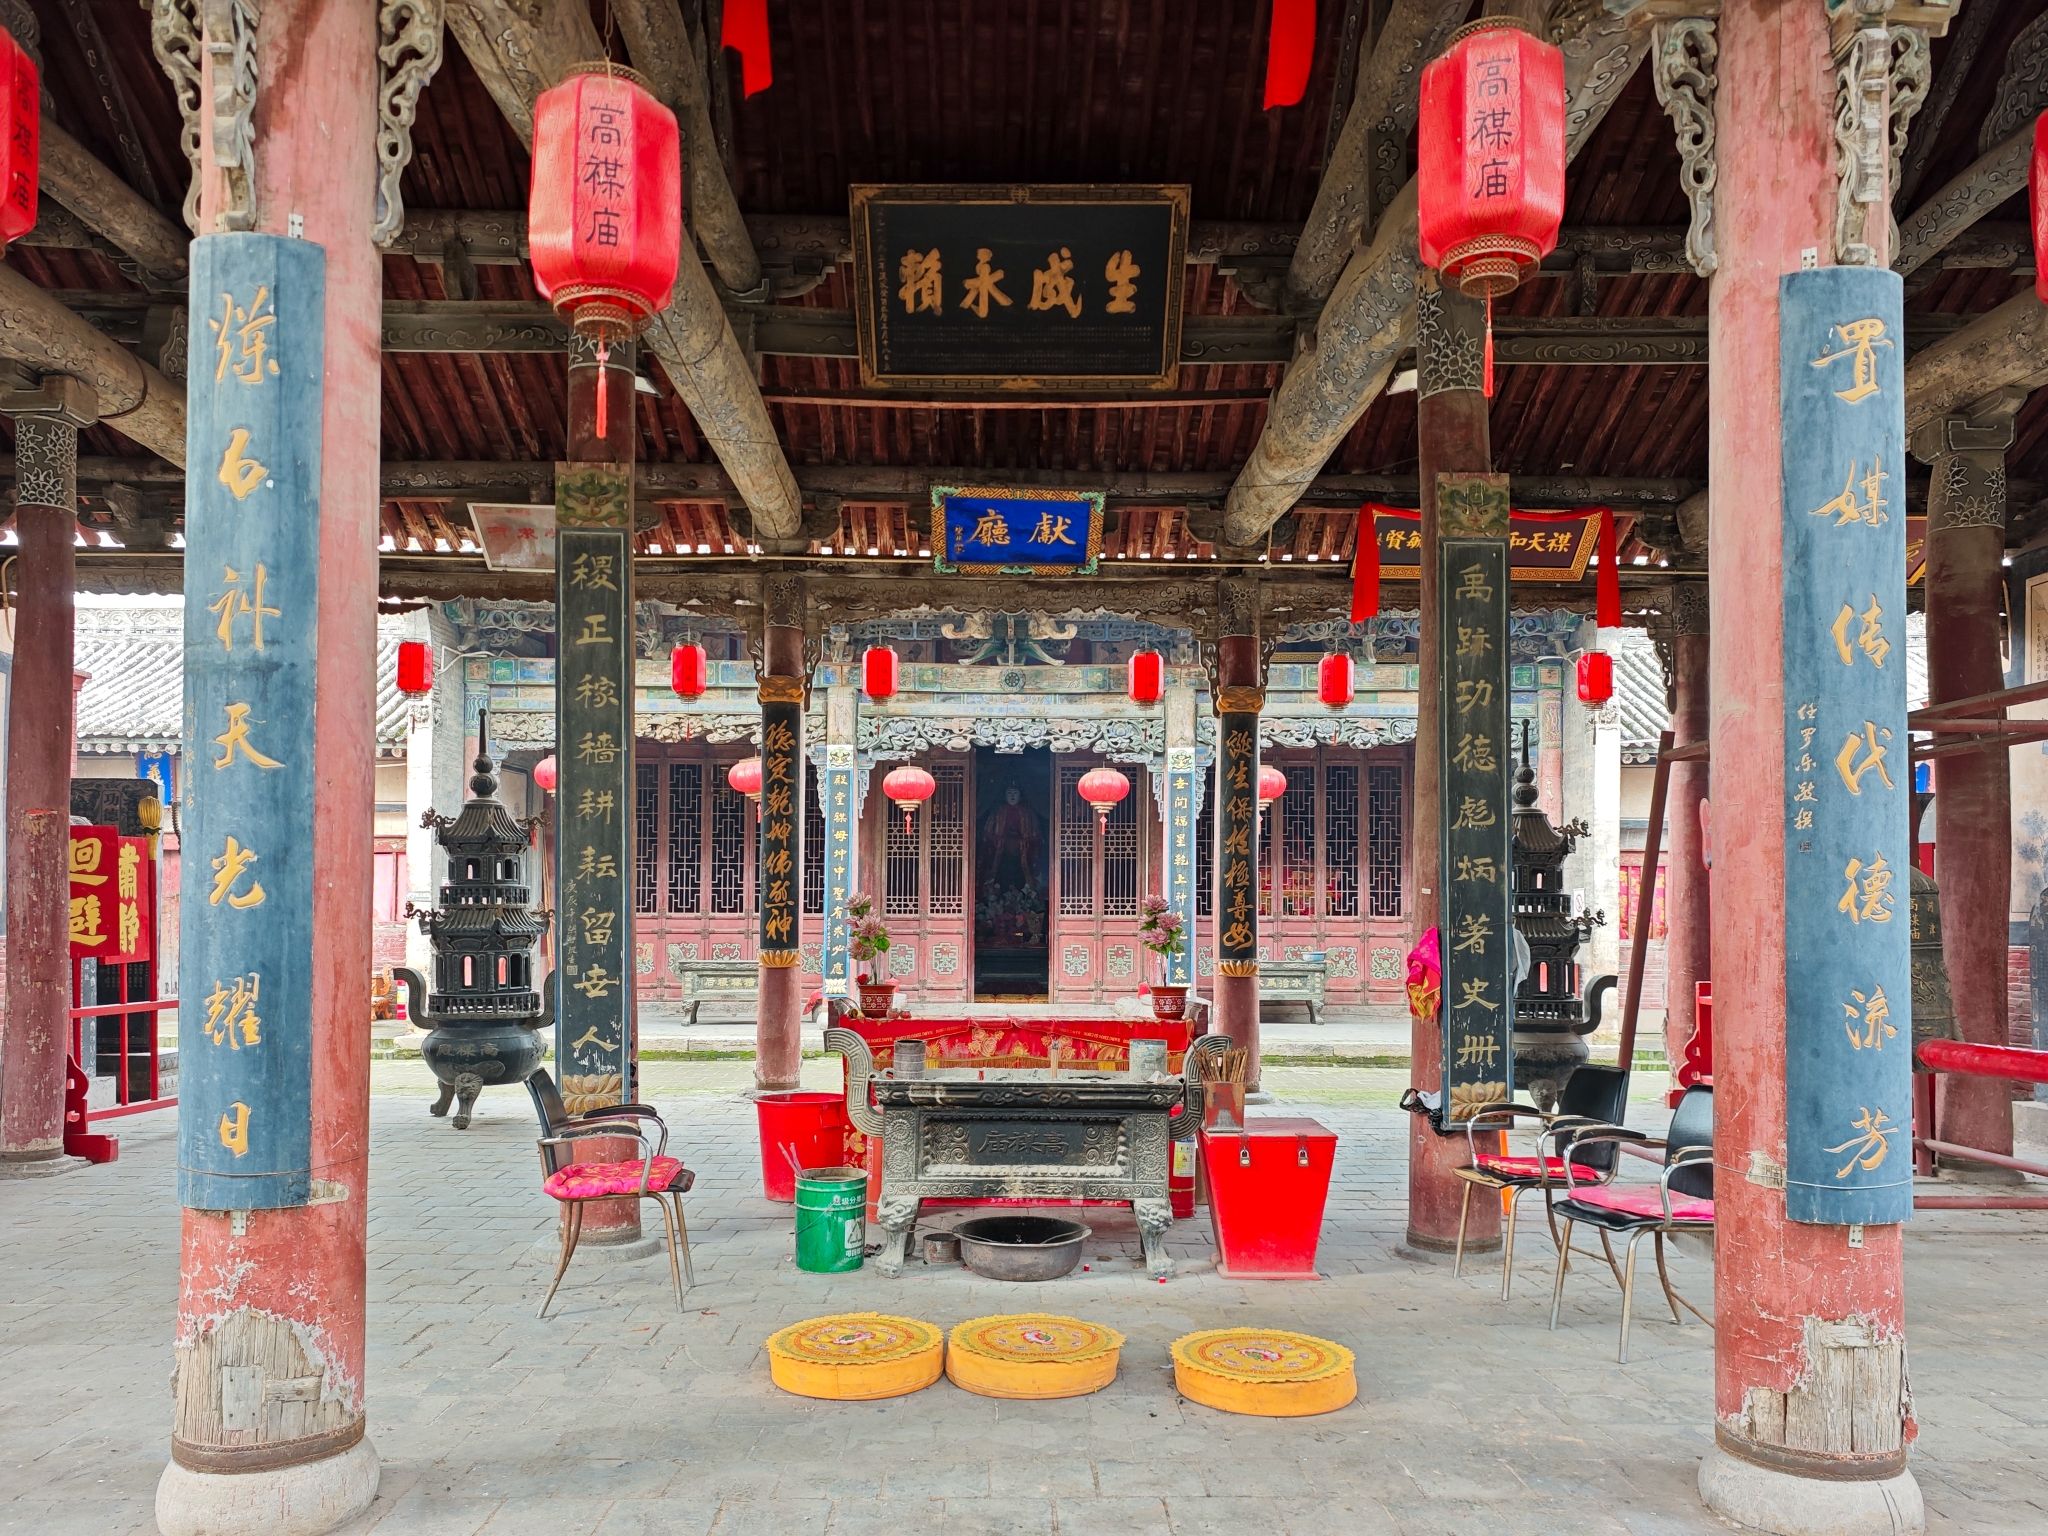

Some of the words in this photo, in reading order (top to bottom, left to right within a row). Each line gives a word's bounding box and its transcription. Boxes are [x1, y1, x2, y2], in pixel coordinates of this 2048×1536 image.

[584, 103, 625, 247] 高禖庙
[1472, 55, 1513, 199] 高禖庙
